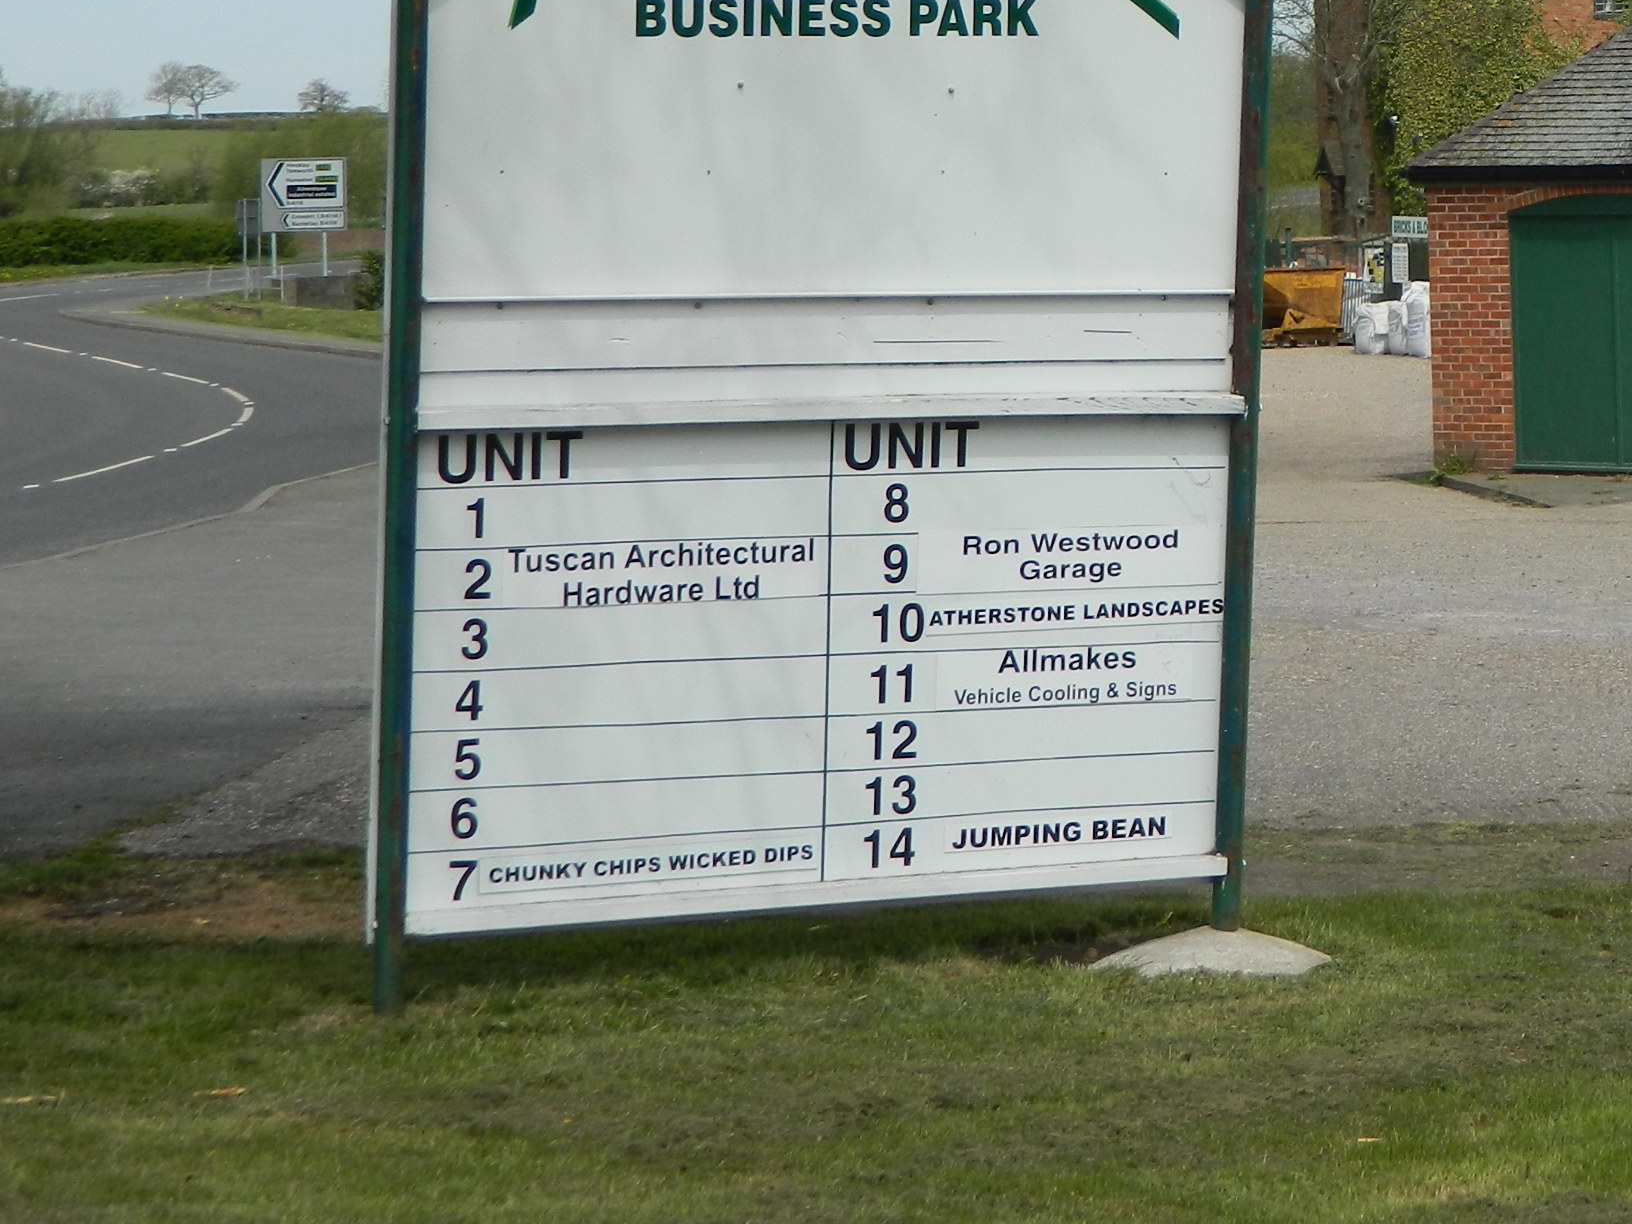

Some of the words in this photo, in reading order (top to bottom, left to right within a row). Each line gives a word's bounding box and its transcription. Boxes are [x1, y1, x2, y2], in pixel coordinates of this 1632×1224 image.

[1393, 219, 1412, 234] BRICKS
[436, 430, 584, 484] UNIT
[843, 421, 981, 471] UNIT
[466, 497, 485, 539] 1
[883, 483, 910, 524] 8
[508, 547, 615, 573] Tuscan
[624, 537, 815, 570] Architectural
[882, 543, 909, 584] 9
[962, 535, 1021, 556] Ron
[1031, 529, 1180, 554] Westwood
[463, 558, 492, 600] 2
[562, 579, 704, 607] Hardware
[715, 575, 761, 601] Ltd
[1018, 559, 1123, 584] Garage
[460, 617, 489, 661] 3
[872, 602, 925, 643] 10
[929, 604, 1076, 627] ATHERSTONE
[1083, 598, 1225, 621] LANDSCAPES
[997, 647, 1138, 675] Allmakes
[455, 679, 484, 721] 4
[870, 663, 914, 704] 11
[954, 687, 1022, 705] Vehicle
[1028, 683, 1101, 704] Cooling
[1106, 682, 1120, 699] &
[1125, 680, 1178, 702] Signs
[454, 738, 482, 781] 5
[865, 719, 918, 761] 12
[865, 774, 918, 816] 13
[450, 797, 479, 840] 6
[863, 827, 916, 869] 14
[952, 821, 1082, 850] JUMPING
[1092, 816, 1167, 840] BEAN
[449, 860, 478, 902] 7
[488, 861, 587, 884] CHUNKY
[593, 856, 661, 877] CHIPS
[668, 849, 757, 871] WICKED
[764, 844, 814, 864] DIPS
